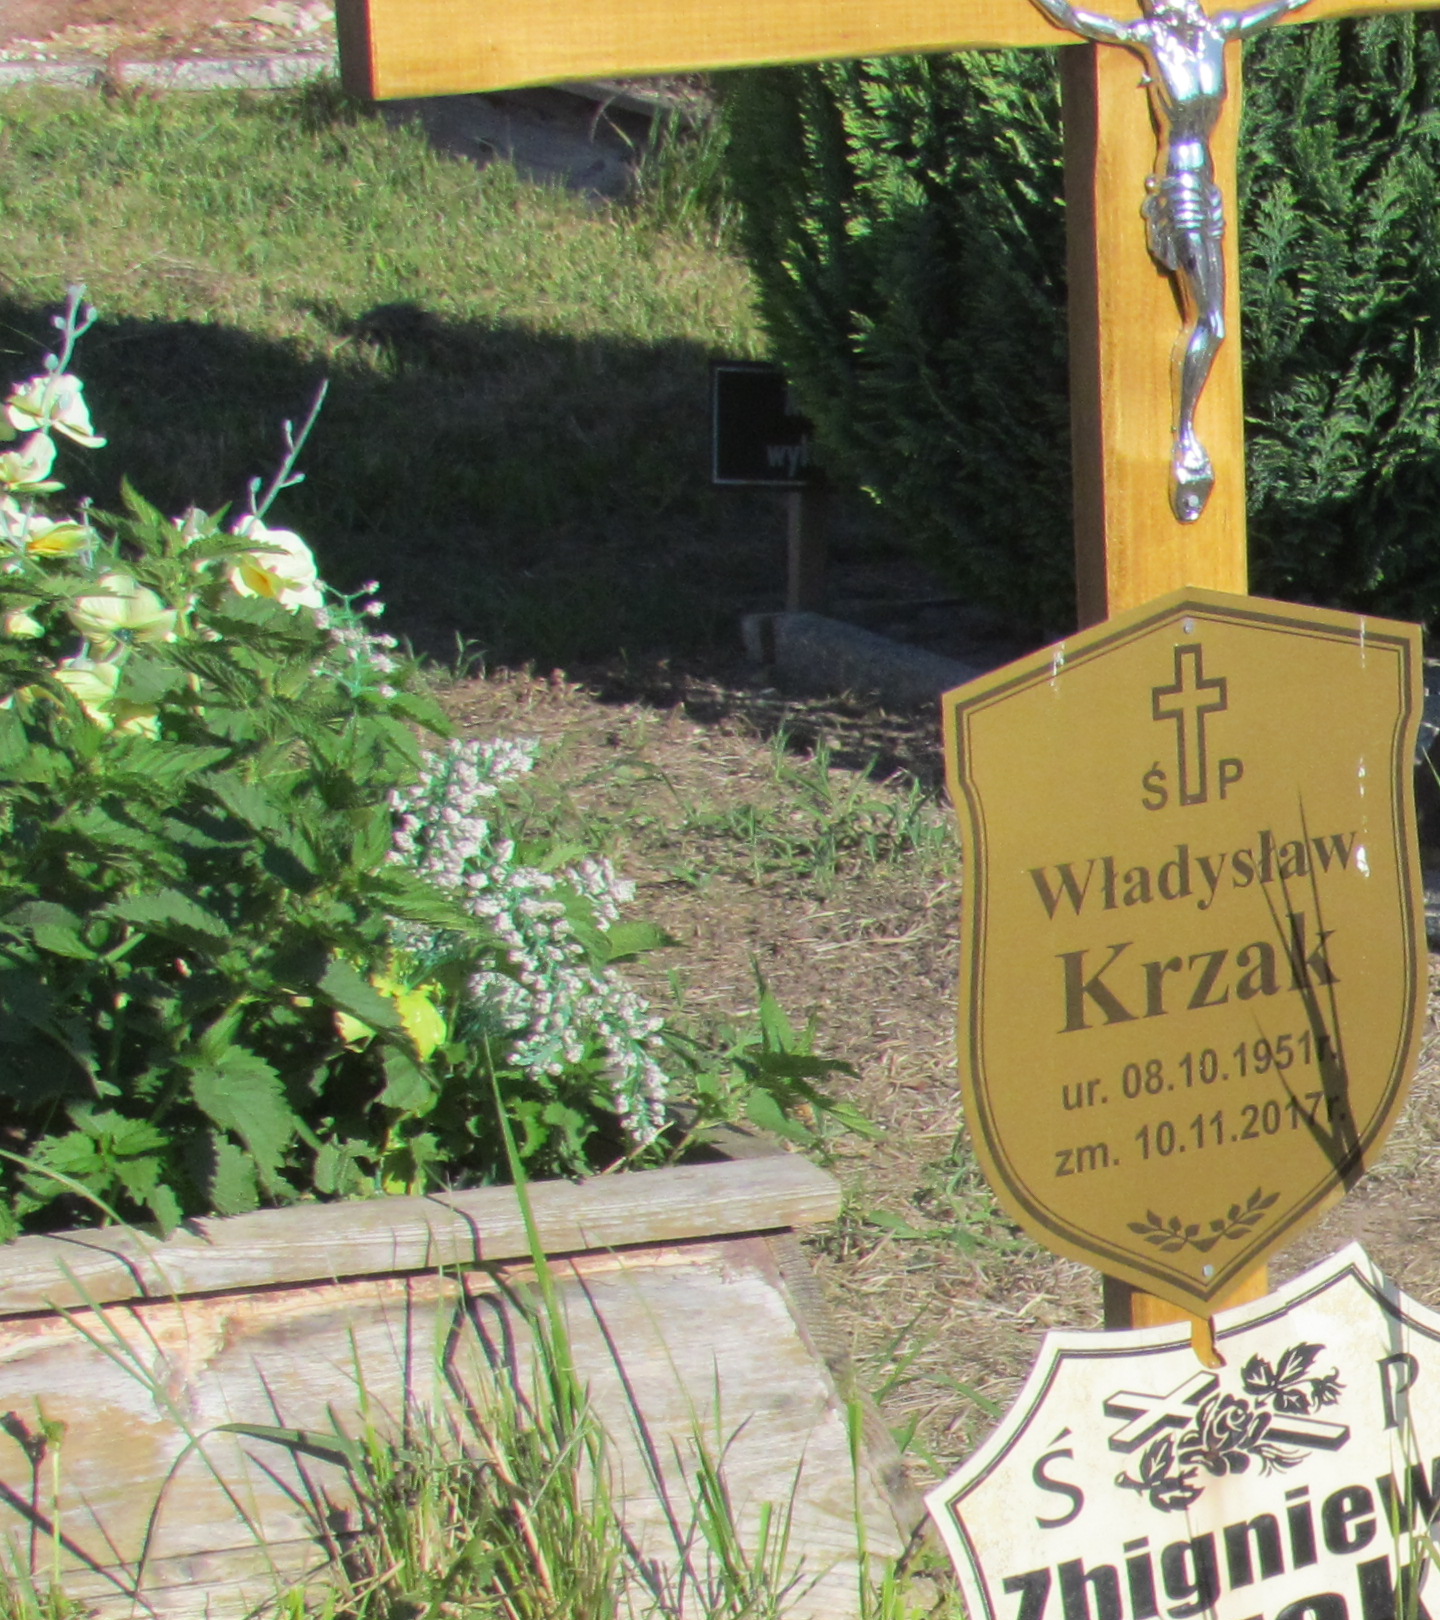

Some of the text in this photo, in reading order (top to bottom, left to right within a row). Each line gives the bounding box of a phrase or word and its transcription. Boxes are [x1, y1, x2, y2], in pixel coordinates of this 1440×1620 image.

[1141, 757, 1244, 811] Ś P
[1029, 829, 1357, 921] Władysław
[1055, 911, 1341, 1034] Krzak
[1061, 1077, 1108, 1111] ur.
[1055, 1142, 1120, 1177] zm.
[1031, 1351, 1420, 1529] Ś P
